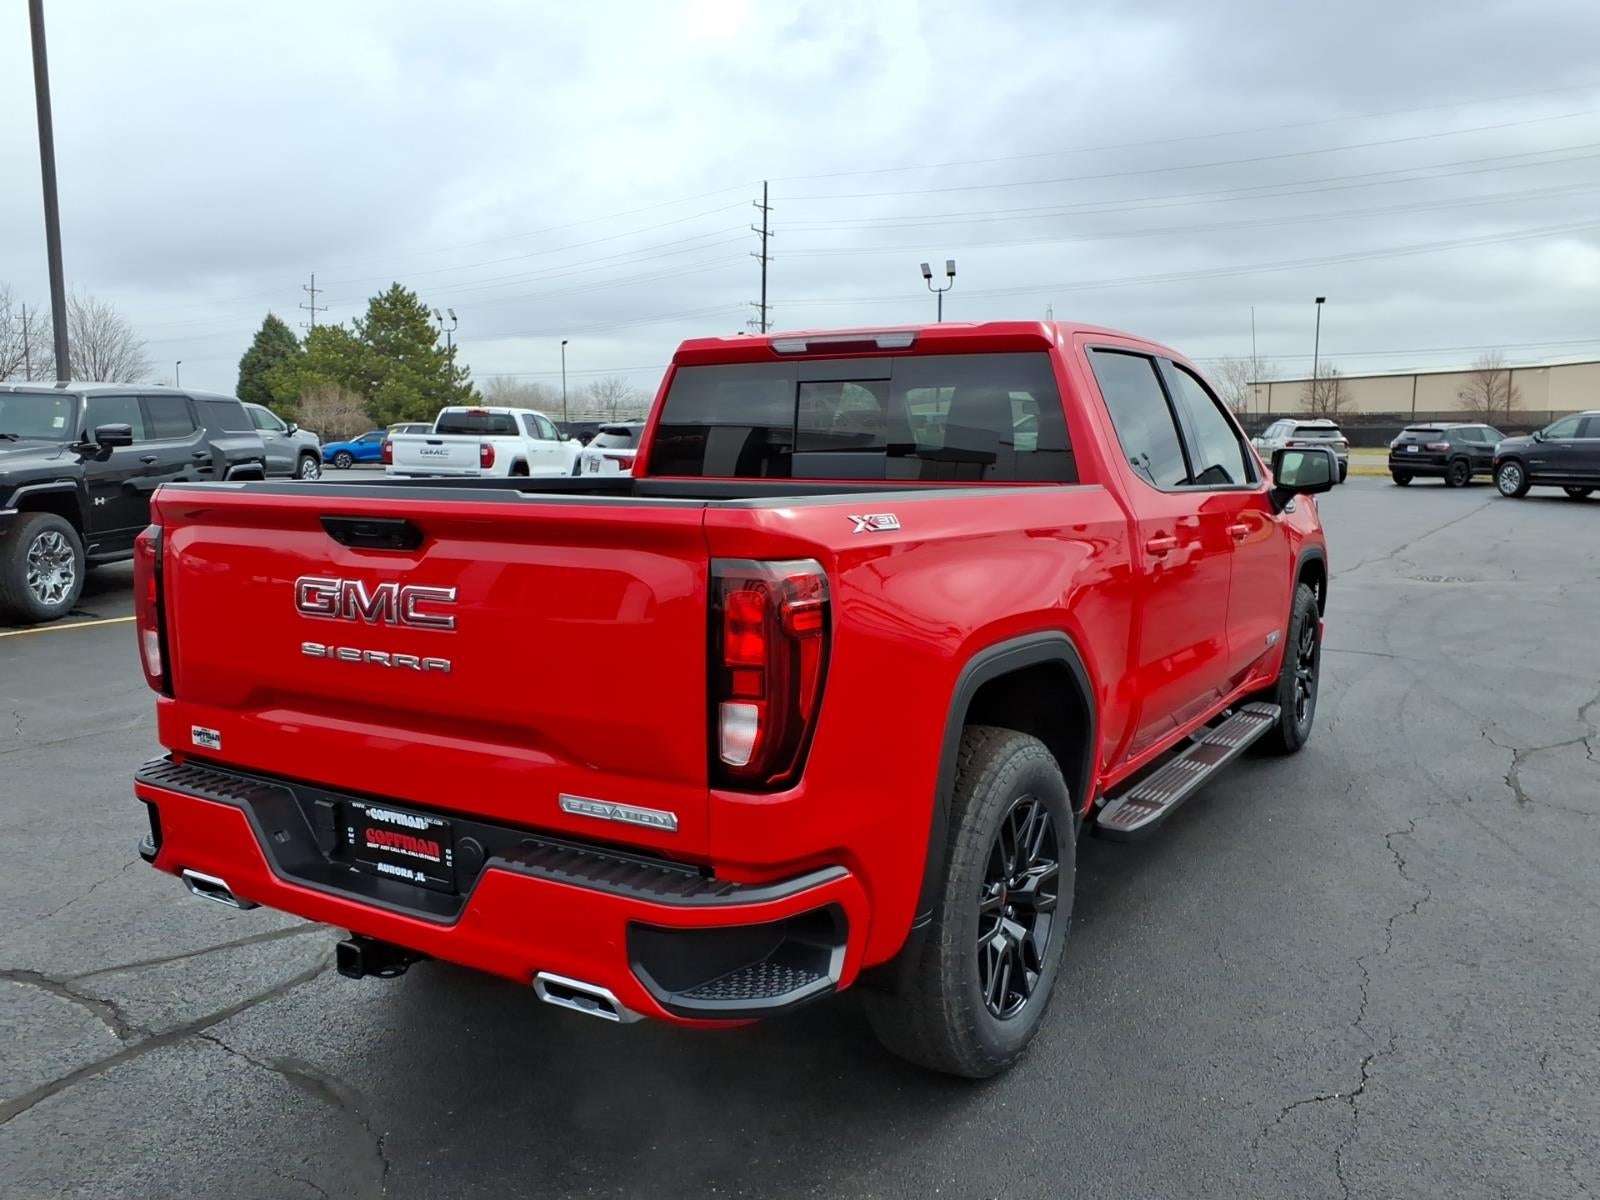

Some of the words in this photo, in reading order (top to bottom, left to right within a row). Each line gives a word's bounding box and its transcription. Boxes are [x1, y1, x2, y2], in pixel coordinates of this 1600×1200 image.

[294, 575, 457, 631] GMC
[301, 641, 452, 673] SIERRA
[370, 807, 425, 830] COFFMAN
[568, 800, 673, 825] ELEVATION
[366, 828, 440, 857] COFFMAN
[377, 862, 414, 879] AURORA
